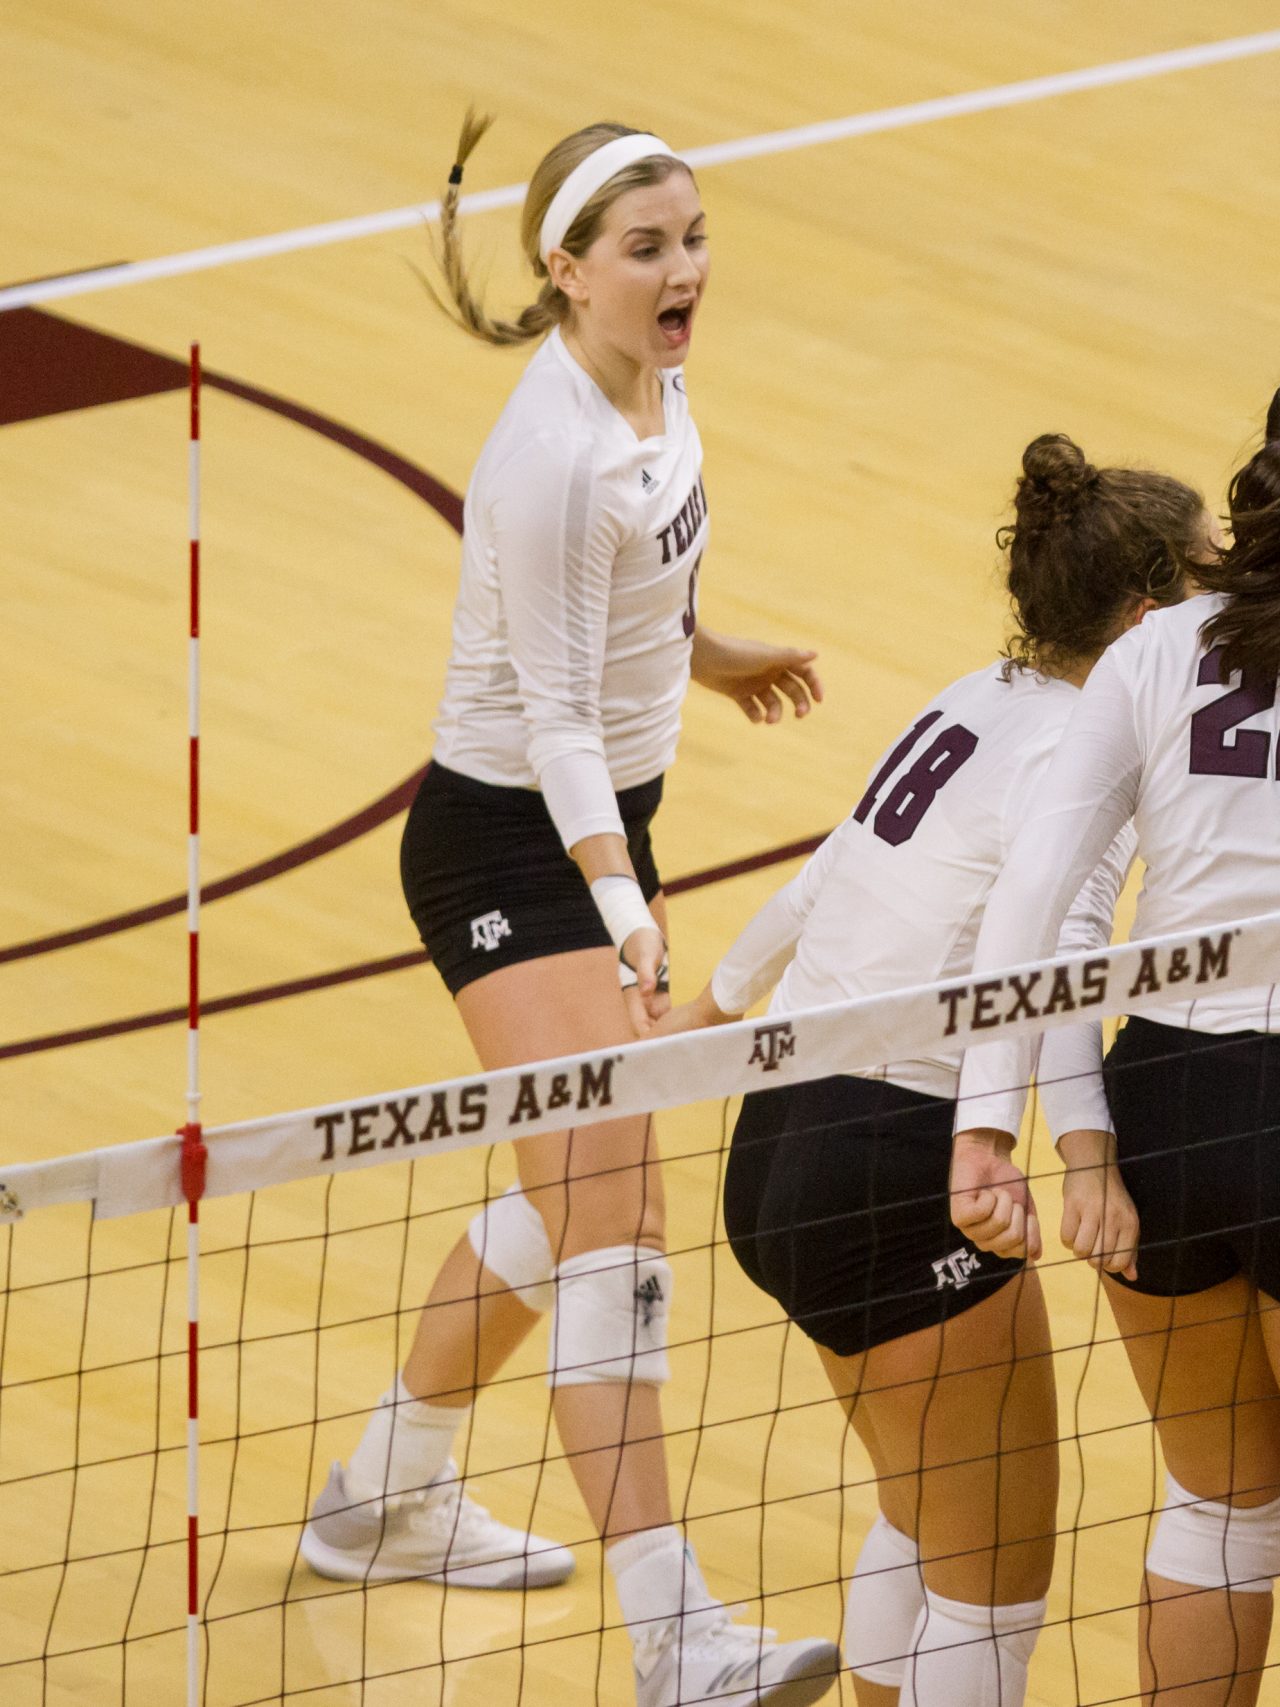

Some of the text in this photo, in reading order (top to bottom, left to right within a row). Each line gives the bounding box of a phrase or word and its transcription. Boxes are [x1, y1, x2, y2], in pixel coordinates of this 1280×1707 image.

[852, 709, 980, 848] 18
[938, 931, 1234, 1037] TEXAS A&M
[314, 1057, 616, 1162] TEXAS A&M
